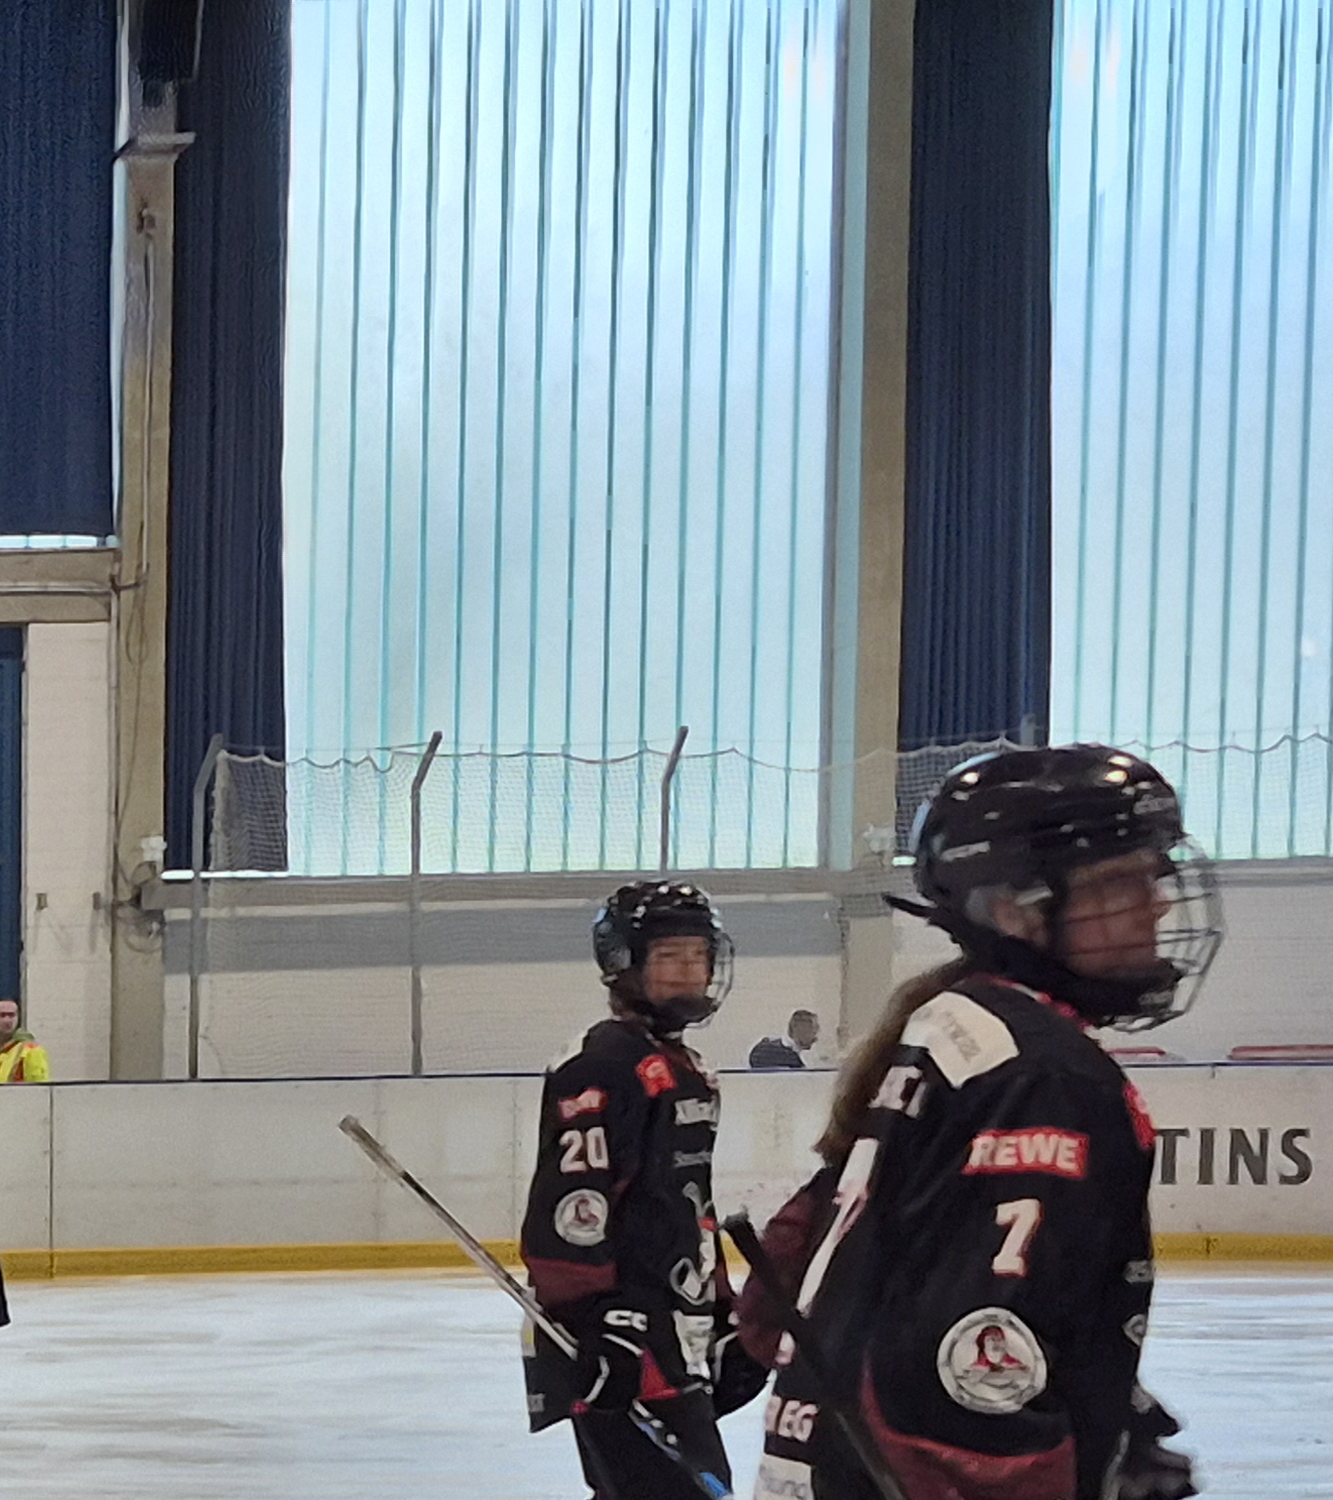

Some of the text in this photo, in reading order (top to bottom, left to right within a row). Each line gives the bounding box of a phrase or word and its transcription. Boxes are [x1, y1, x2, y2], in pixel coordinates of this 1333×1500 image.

[559, 1126, 609, 1173] 20
[967, 1133, 1079, 1171] REWE
[1154, 1127, 1313, 1185] TINS
[991, 1198, 1041, 1276] 7
